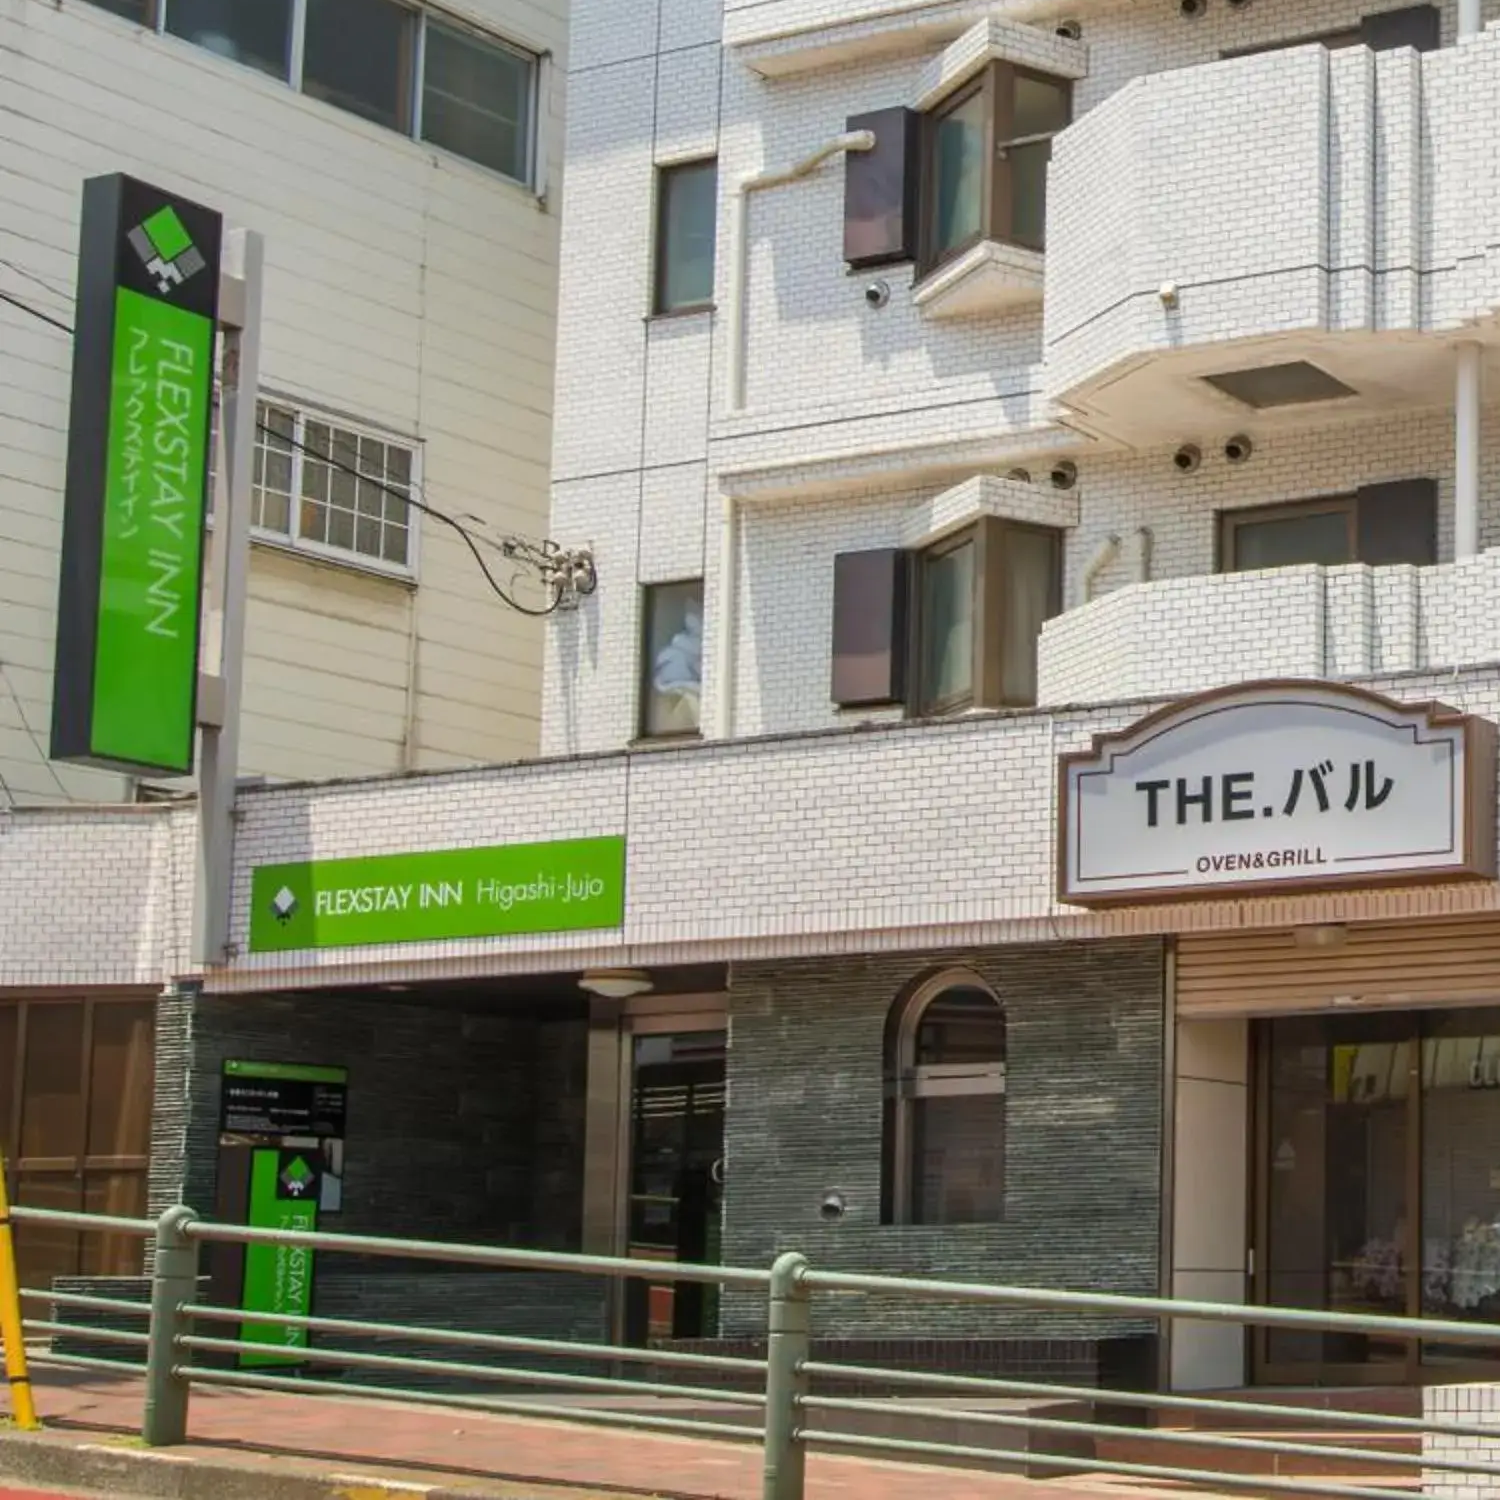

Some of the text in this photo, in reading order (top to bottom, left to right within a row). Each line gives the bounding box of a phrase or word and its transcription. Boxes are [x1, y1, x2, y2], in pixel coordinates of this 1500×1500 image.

[144, 337, 194, 638] FLEXSTAY INN
[1196, 848, 1327, 873] OVEN&GRILL
[315, 872, 604, 917] FLEXSTAY INN Higashi-Jujo
